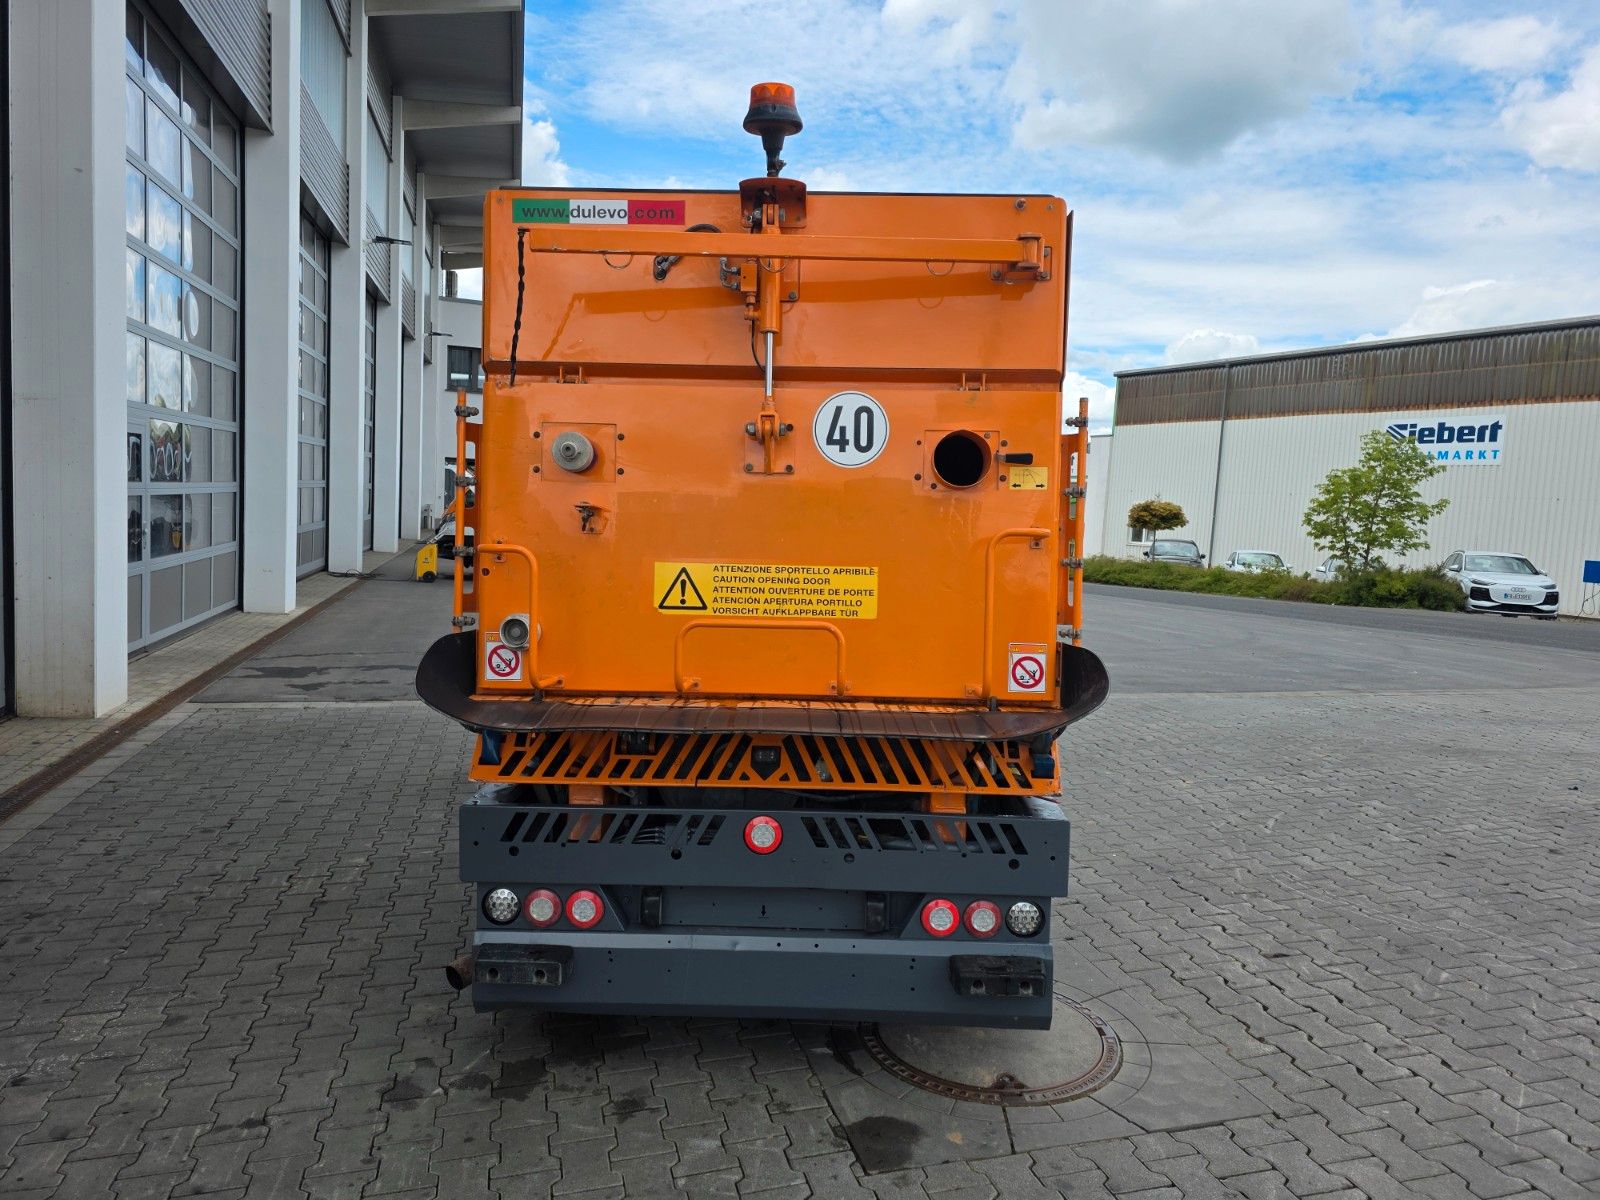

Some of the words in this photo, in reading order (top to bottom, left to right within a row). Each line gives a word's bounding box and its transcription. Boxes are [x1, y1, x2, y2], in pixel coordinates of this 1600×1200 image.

[522, 204, 675, 219] www.dulevo.com
[826, 405, 875, 453] 40
[713, 565, 772, 574] ATTENZIONE
[774, 566, 830, 575] SPORTELLO
[832, 568, 875, 576] APRIBILE
[713, 575, 755, 584] CAUTION
[757, 576, 800, 585] OPENING
[803, 577, 831, 586] DOOR
[713, 586, 765, 595] ATTENTION
[768, 587, 825, 596] OUVERTURE
[828, 588, 841, 596] DE
[843, 589, 875, 597] PORTE
[763, 597, 814, 606] APERTURA
[816, 599, 863, 607] PORTILLO
[712, 607, 760, 615] VORSICHT
[762, 608, 837, 617] AUFKLAPPBARE
[839, 608, 859, 617] TÜR
